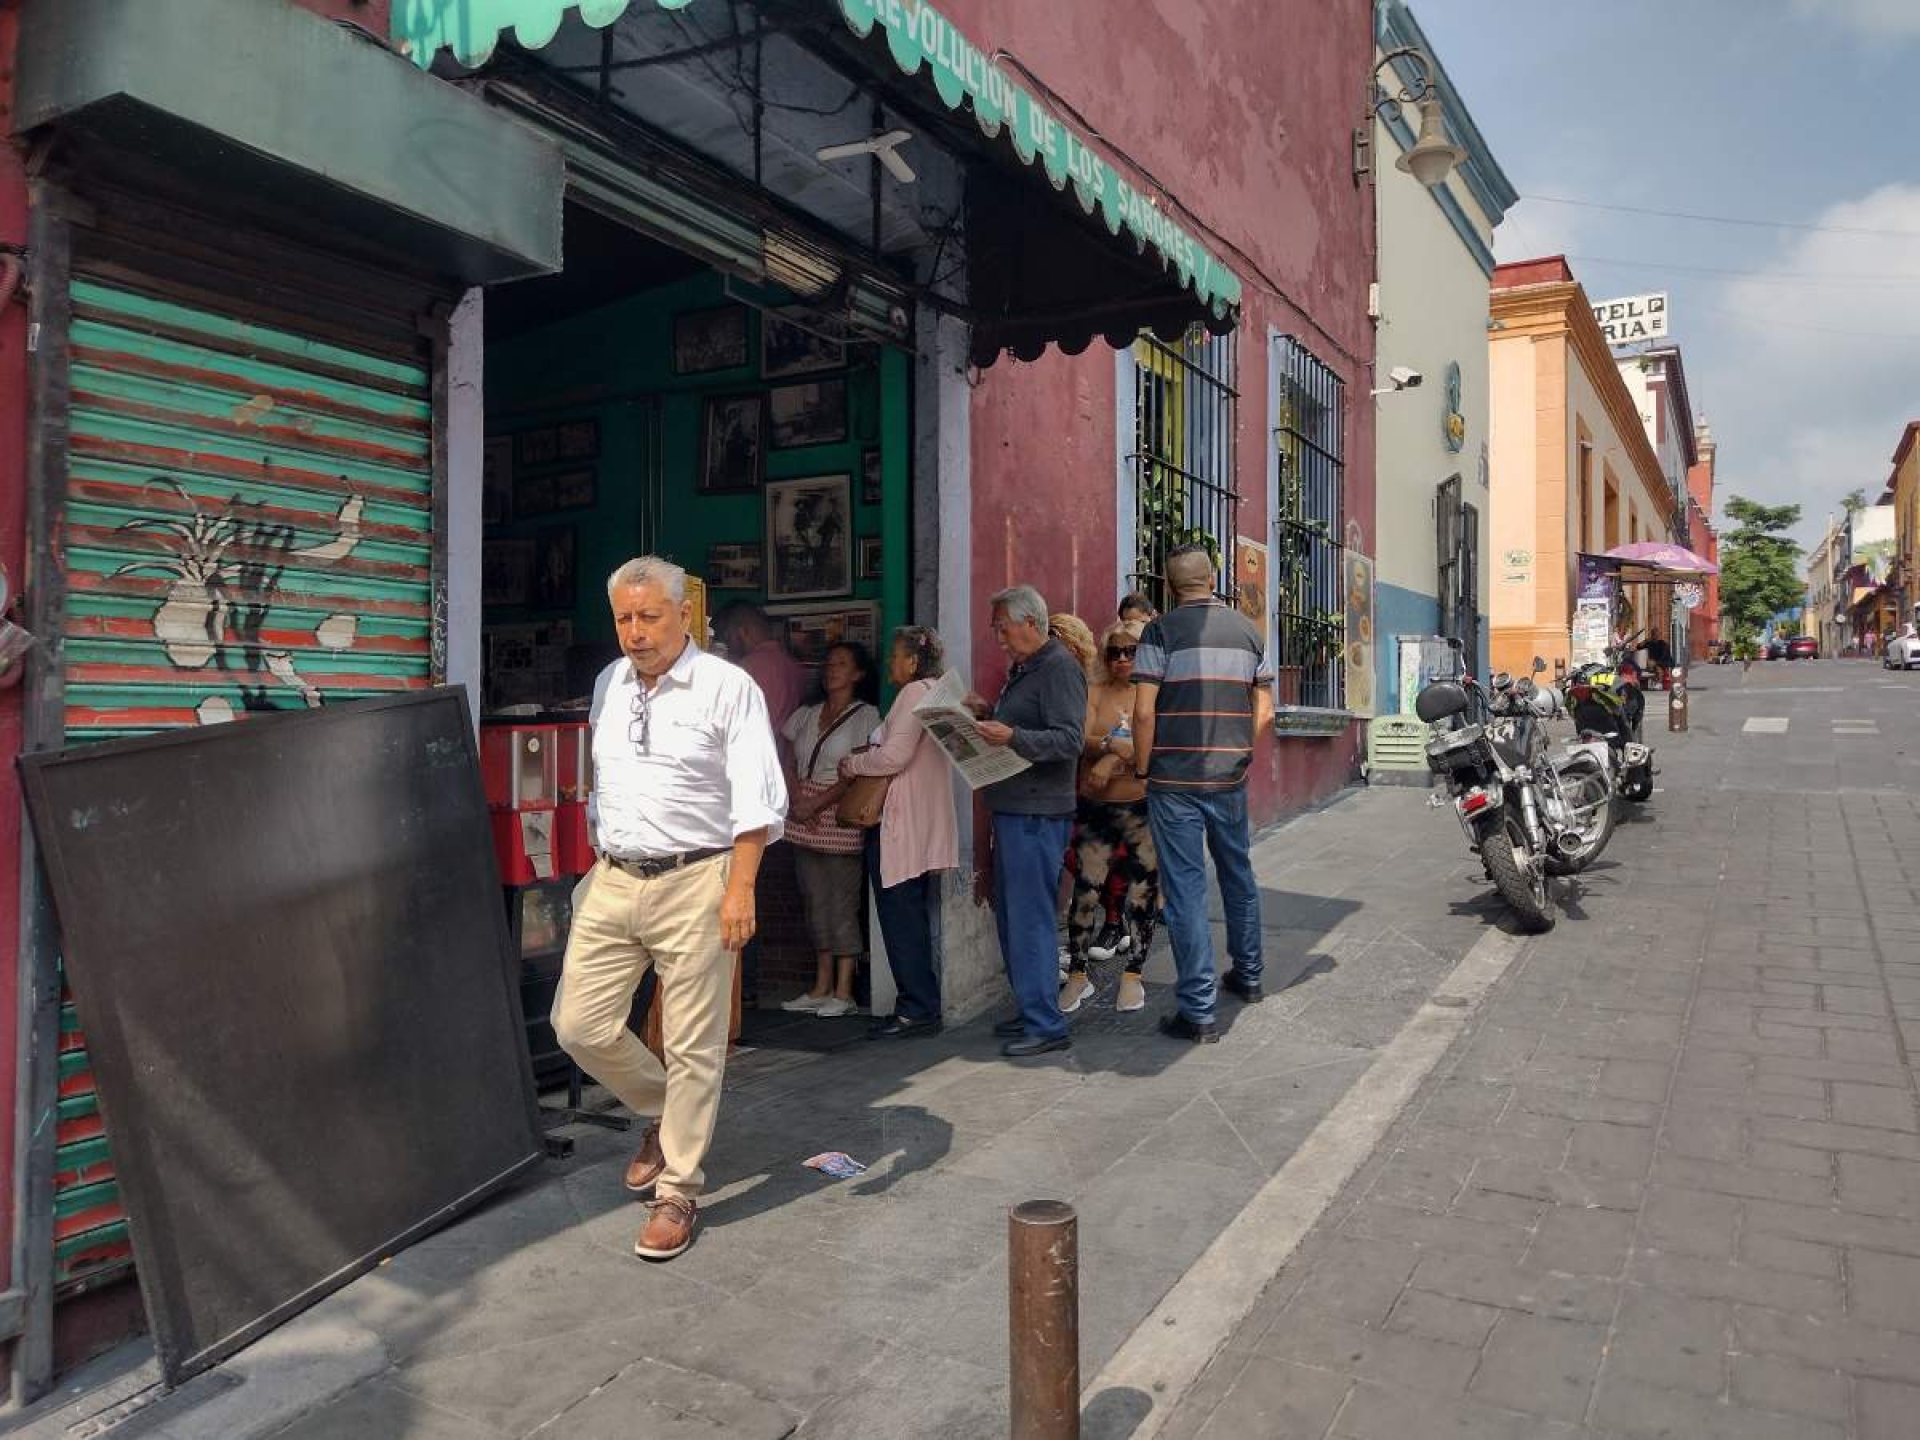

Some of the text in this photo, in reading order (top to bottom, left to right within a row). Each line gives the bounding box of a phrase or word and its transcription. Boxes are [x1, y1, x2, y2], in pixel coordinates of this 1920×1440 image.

[1029, 98, 1056, 155] DE
[1066, 132, 1104, 197] LOS
[1117, 177, 1194, 270] SABORES
[1652, 319, 1662, 329] E
